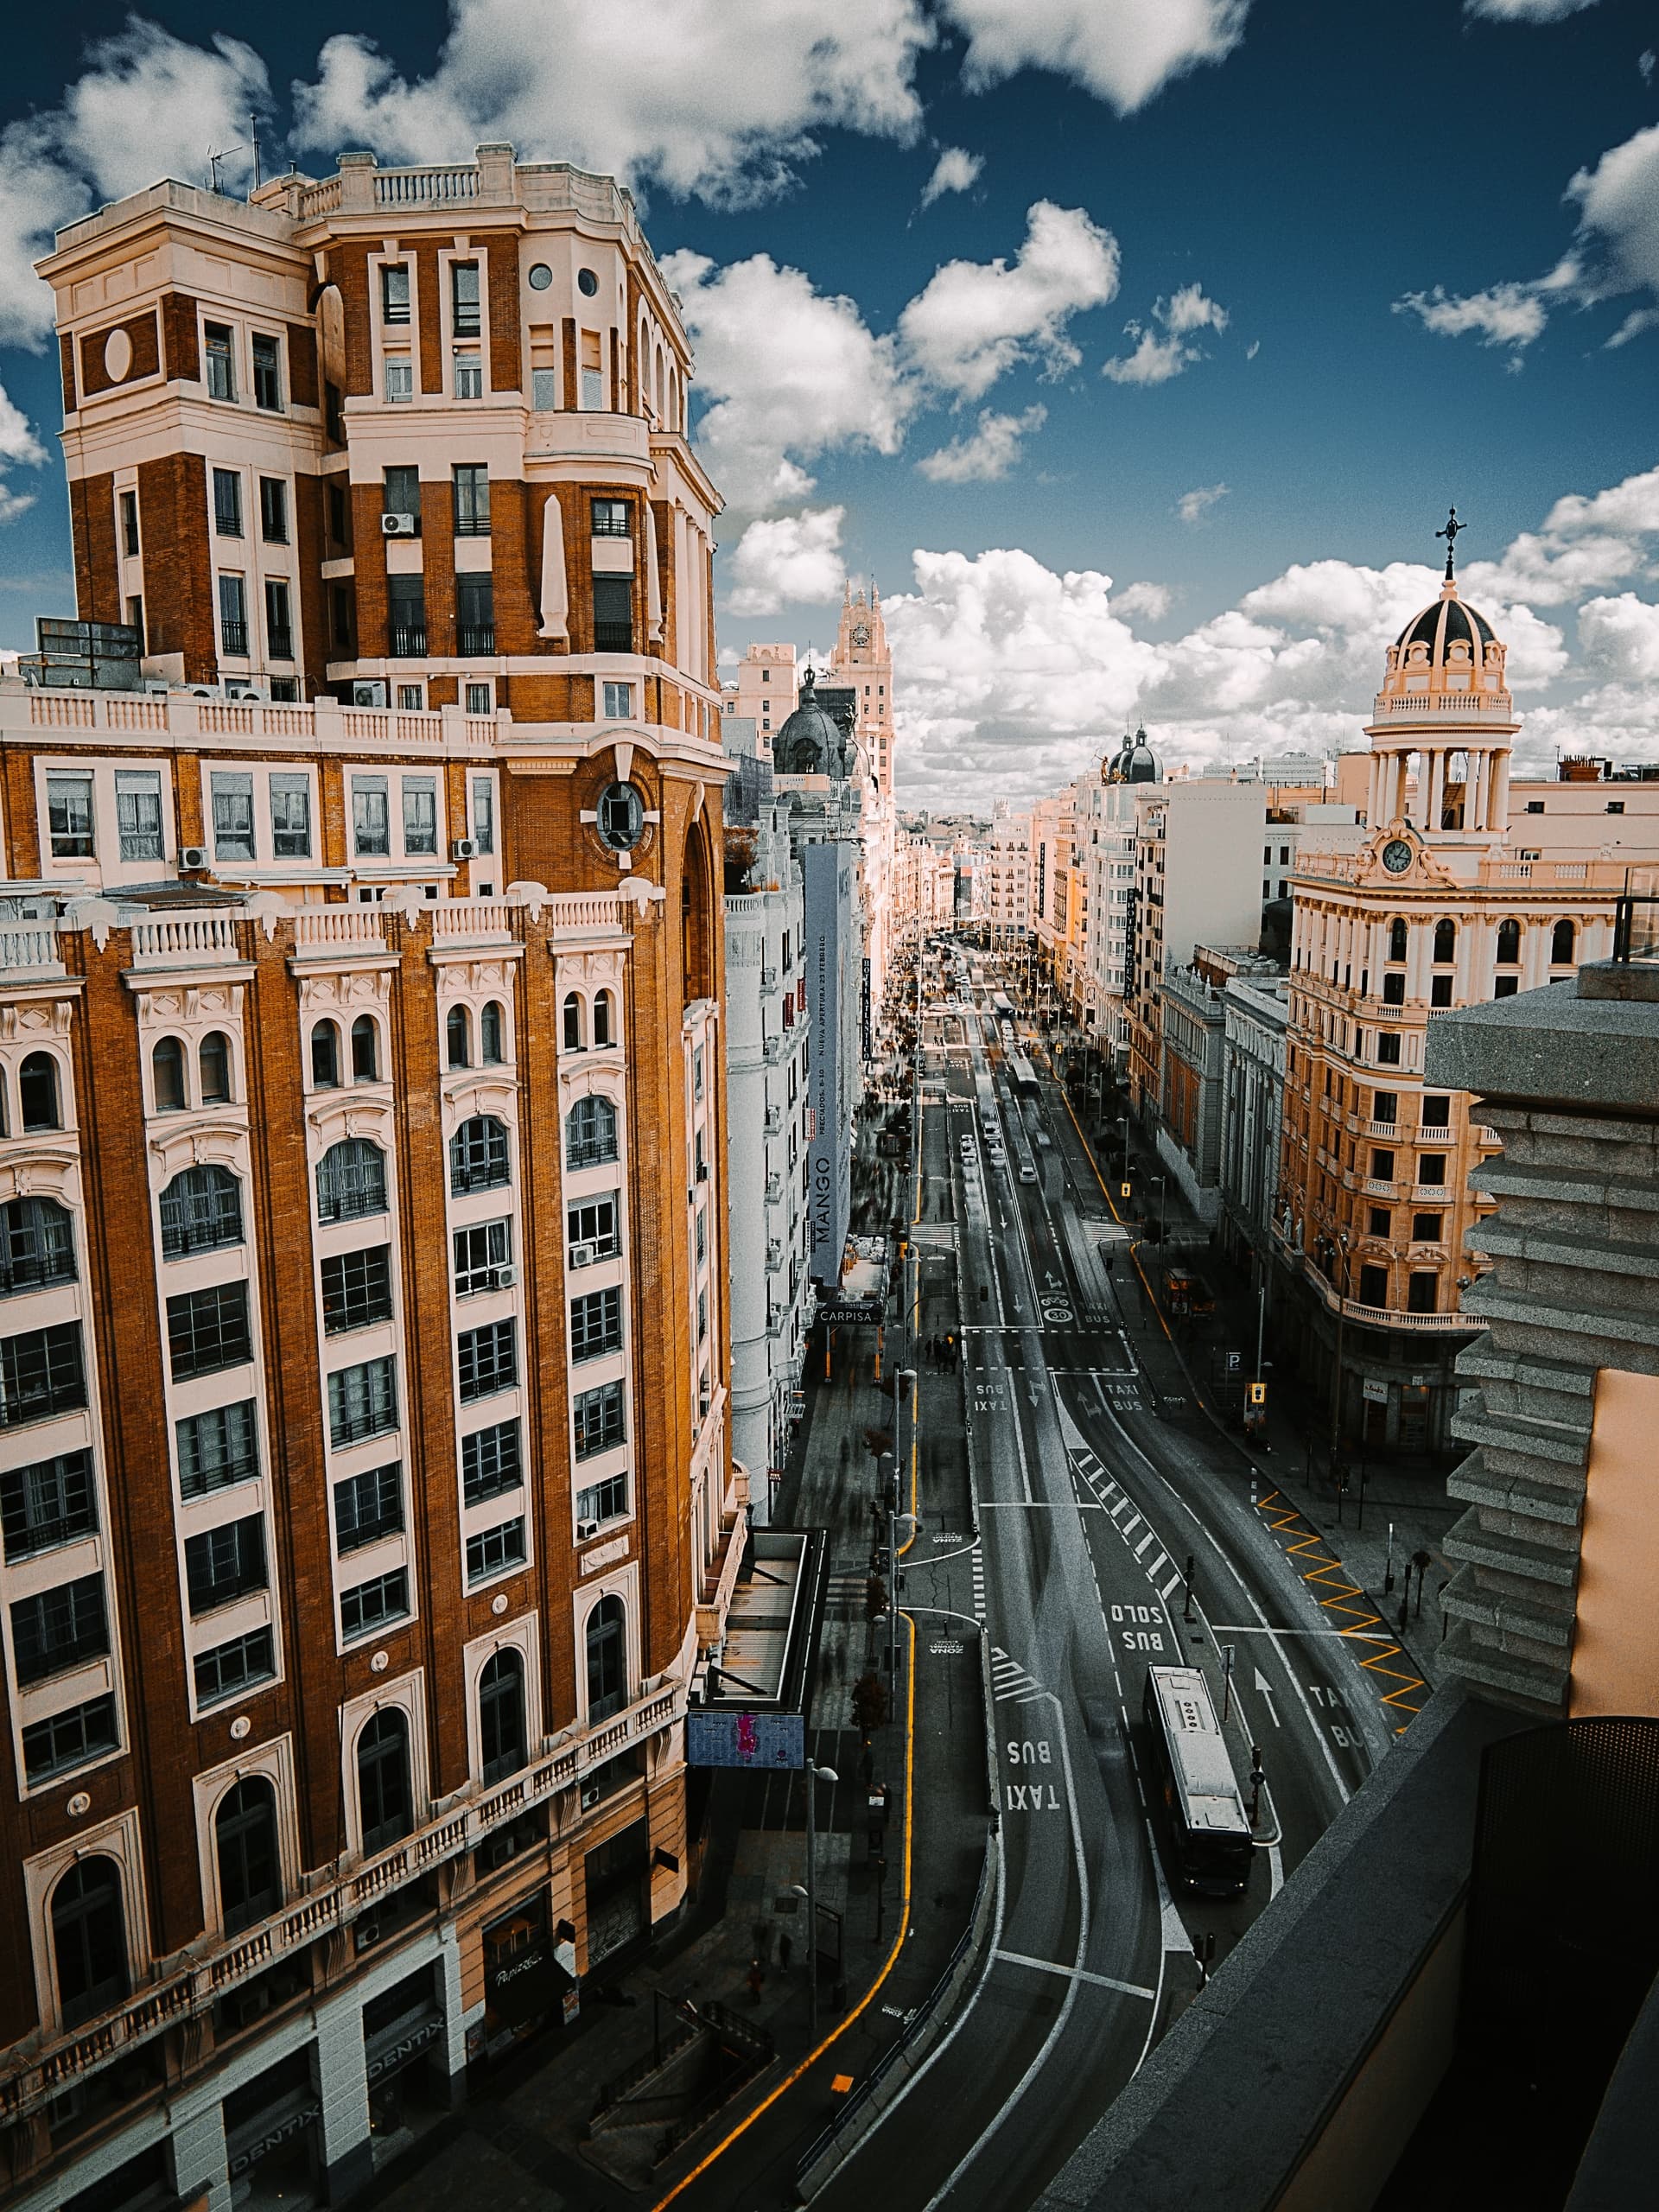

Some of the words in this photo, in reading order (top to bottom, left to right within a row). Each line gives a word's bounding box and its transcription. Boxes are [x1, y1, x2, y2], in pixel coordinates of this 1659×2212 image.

[1125, 944, 1134, 998] REGENTE
[816, 1157, 830, 1243] MANGO
[820, 1312, 872, 1322] CARPISA
[1052, 1311, 1066, 1319] 30
[1084, 1314, 1110, 1324] BUS
[1230, 1354, 1241, 1367] P
[976, 1384, 1003, 1395] BUS
[1104, 1384, 1140, 1395] TAXI
[974, 1401, 1007, 1411] TAXI
[1114, 1400, 1143, 1411] BUS
[1111, 1604, 1164, 1624] SOLO
[1122, 1631, 1165, 1651] BUS
[1007, 1739, 1052, 1764] BUS
[1007, 1783, 1061, 1811] TAXI
[367, 2016, 446, 2081] DENTIX
[230, 2103, 321, 2177] DENTIX
